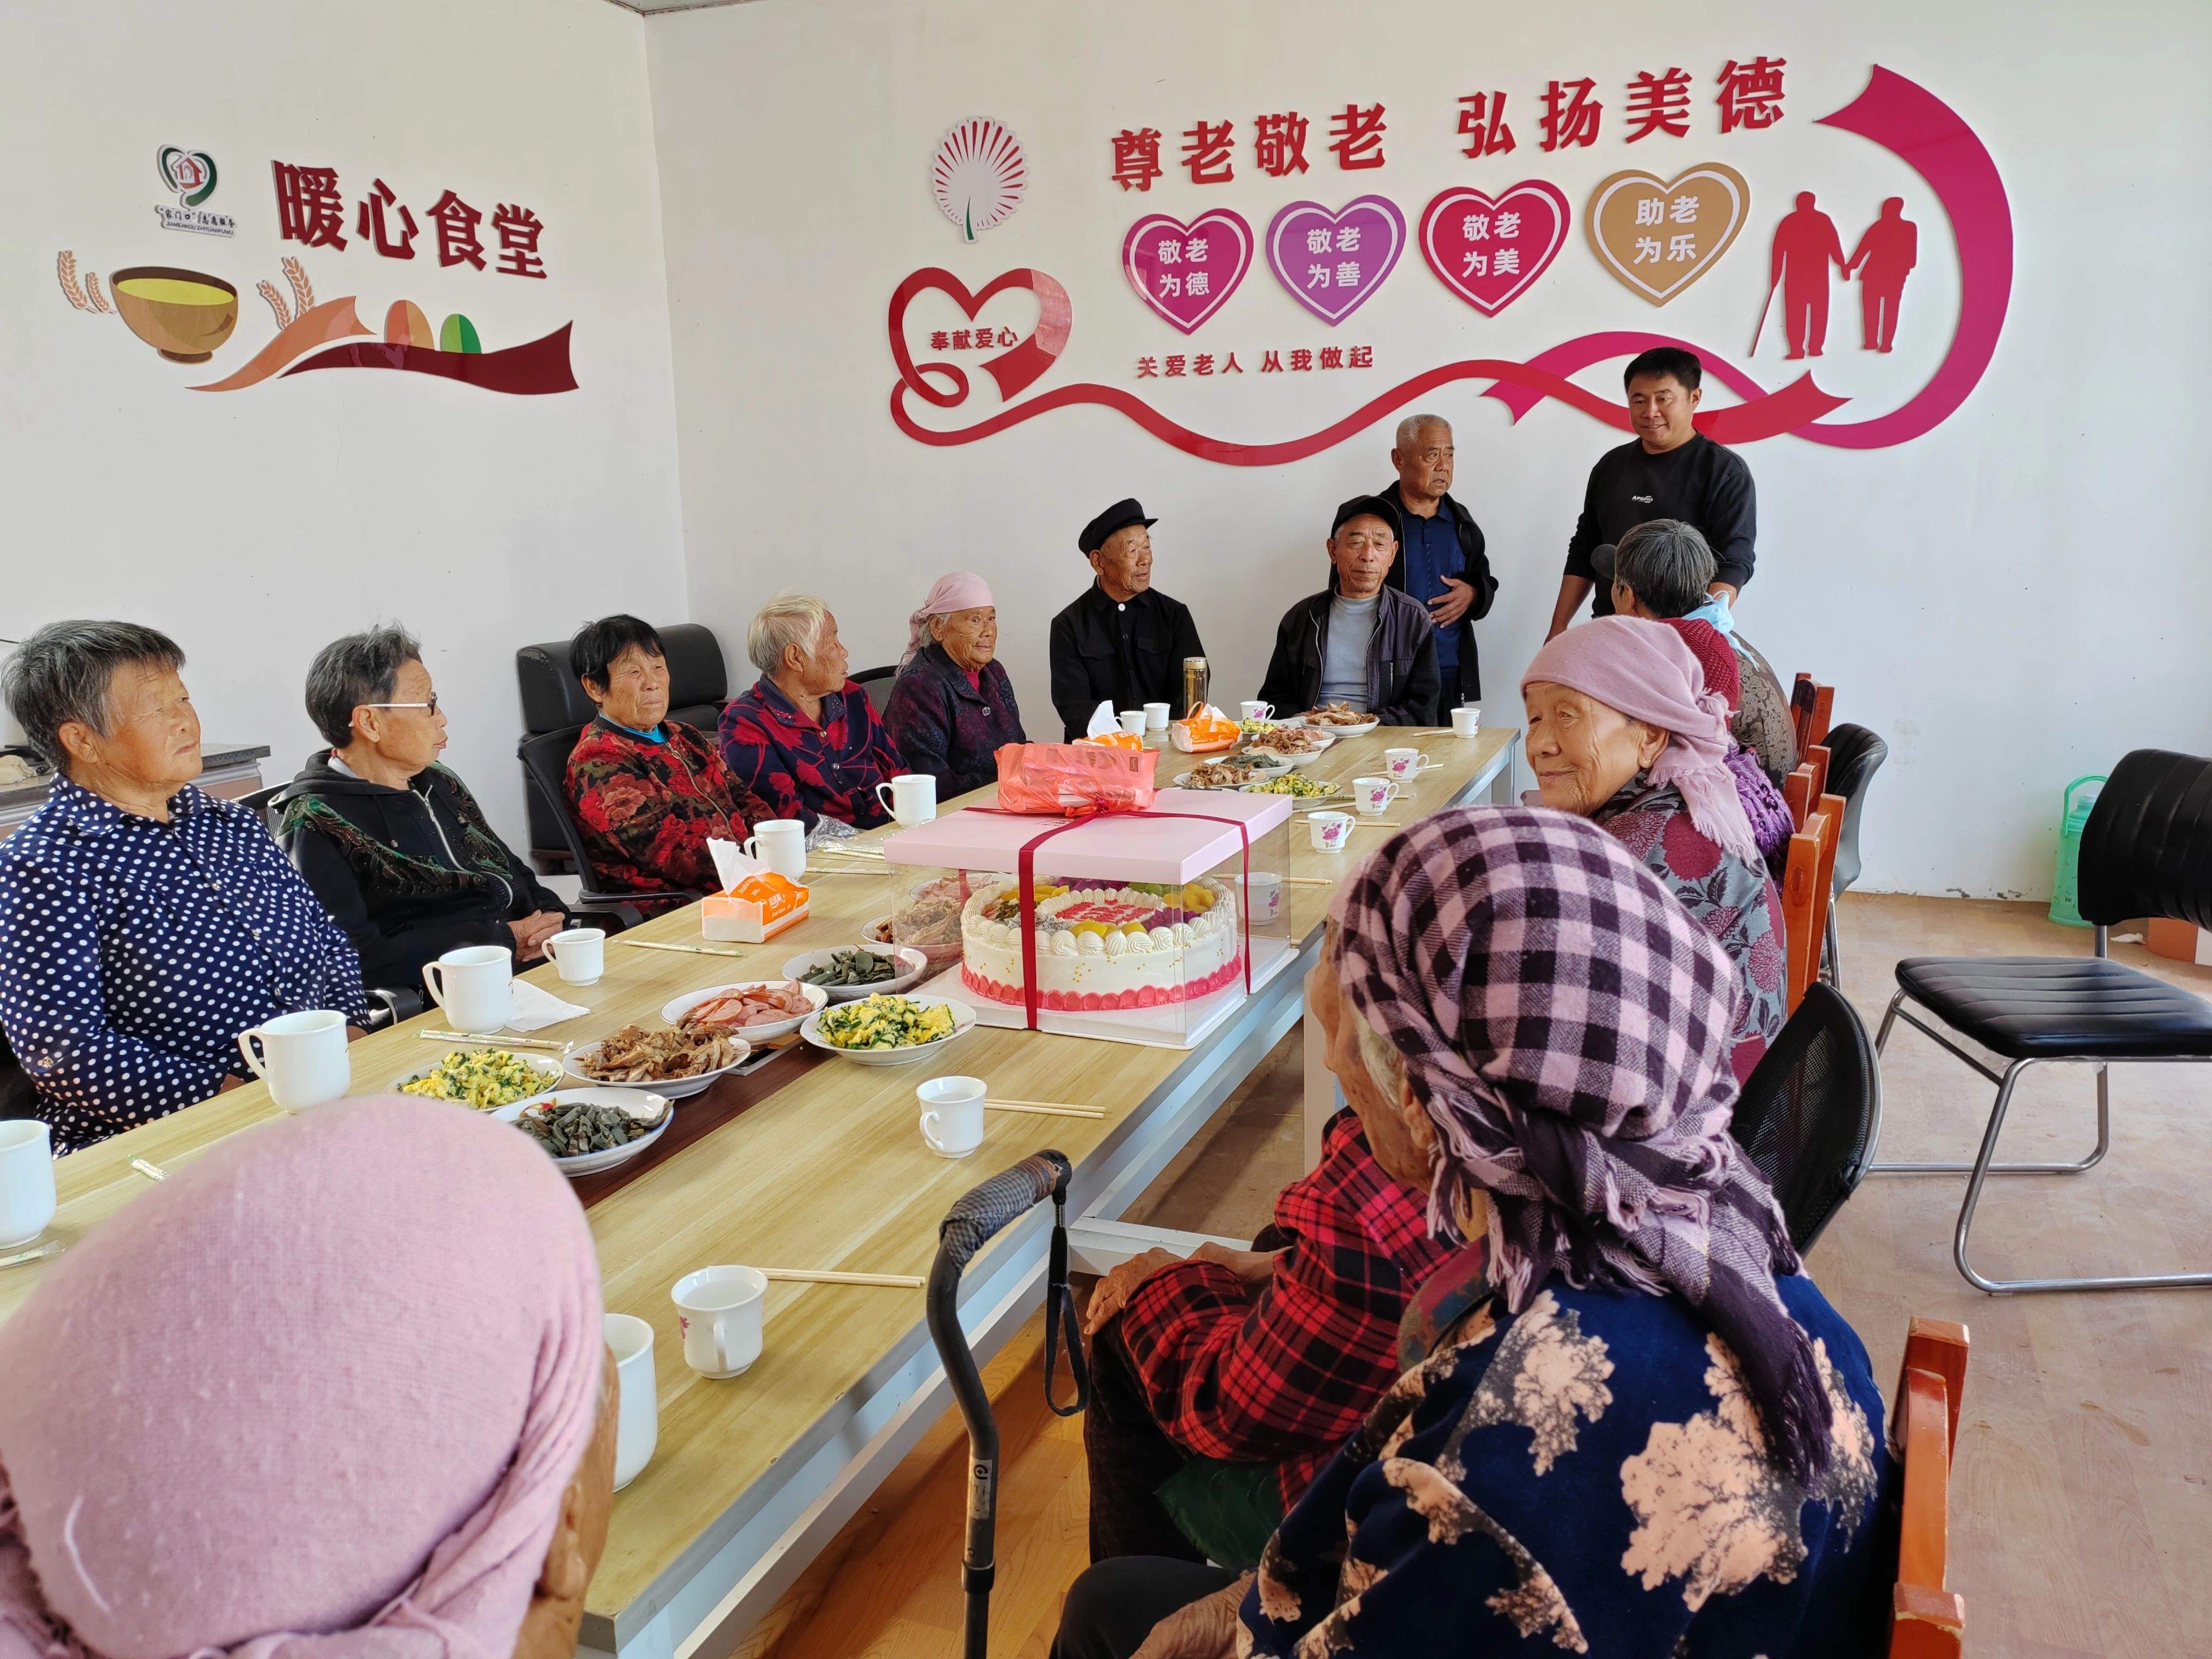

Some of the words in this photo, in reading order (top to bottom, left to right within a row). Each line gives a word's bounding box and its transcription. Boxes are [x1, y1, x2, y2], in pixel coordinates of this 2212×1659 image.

[1111, 103, 1387, 192] 尊老敬老
[1456, 56, 1787, 159] 弘扬美德
[273, 160, 548, 279] 暖心食堂
[1634, 195, 1700, 226] 助老
[1306, 226, 1361, 254] 敬老
[1462, 212, 1521, 241] 敬老
[1157, 238, 1209, 264] 敬老
[1461, 248, 1521, 278] 为美
[1634, 233, 1697, 264] 为乐
[1159, 271, 1210, 296] 为德
[1307, 261, 1361, 290] 为善
[930, 326, 1018, 350] 奉献爱心
[1137, 352, 1244, 379] 关爱老人
[1260, 345, 1373, 373] 从我做起
